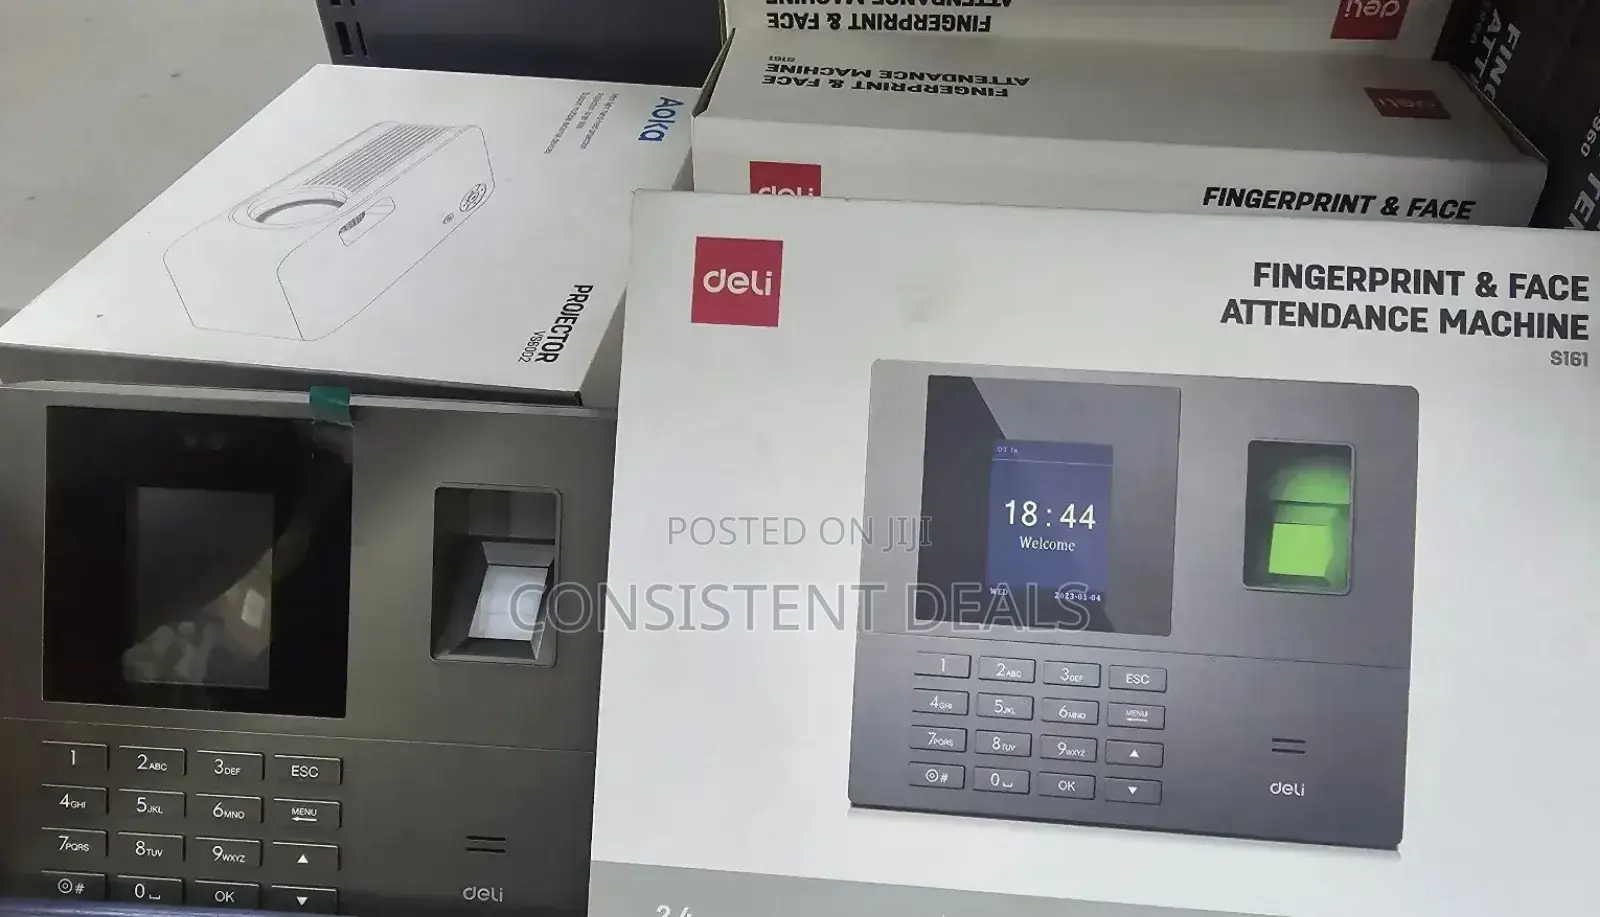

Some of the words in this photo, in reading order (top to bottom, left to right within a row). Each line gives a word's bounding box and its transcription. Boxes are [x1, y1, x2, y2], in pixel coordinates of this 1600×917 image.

[766, 12, 820, 30] FACE
[826, 13, 841, 30] &
[848, 13, 992, 33] FINGERPRINT
[765, 63, 872, 78] MACHINE
[879, 70, 1030, 86] ATTENDANCE
[762, 75, 821, 88] FACE
[828, 79, 844, 89] &
[851, 81, 1009, 98] FINGERPRINT
[638, 96, 684, 142] Aoka
[1203, 186, 1376, 214] FINGERPRINT
[1380, 196, 1399, 216] &
[1406, 198, 1476, 220] FACE
[703, 268, 773, 296] deli
[1253, 261, 1465, 298] FINGERPRINT
[1475, 270, 1498, 299] &
[1509, 273, 1590, 302] FACE
[534, 284, 594, 363] PROJECTOR
[1220, 298, 1428, 333] ATTENDANCE
[1439, 308, 1590, 341] MACHINE
[1550, 350, 1589, 368] S161
[1004, 499, 1097, 530] 18:44
[1019, 535, 1076, 551] Welcome
[990, 588, 1009, 596] WED
[1054, 591, 1101, 602] 2023-01-04
[940, 658, 946, 673] 1
[1126, 674, 1150, 685] ESC
[70, 750, 76, 765] 1
[291, 765, 319, 779] ESC
[1058, 780, 1076, 792] OK
[1269, 782, 1305, 797] deli
[291, 807, 317, 817] MENU
[214, 890, 234, 903] OK
[462, 886, 503, 903] deli
